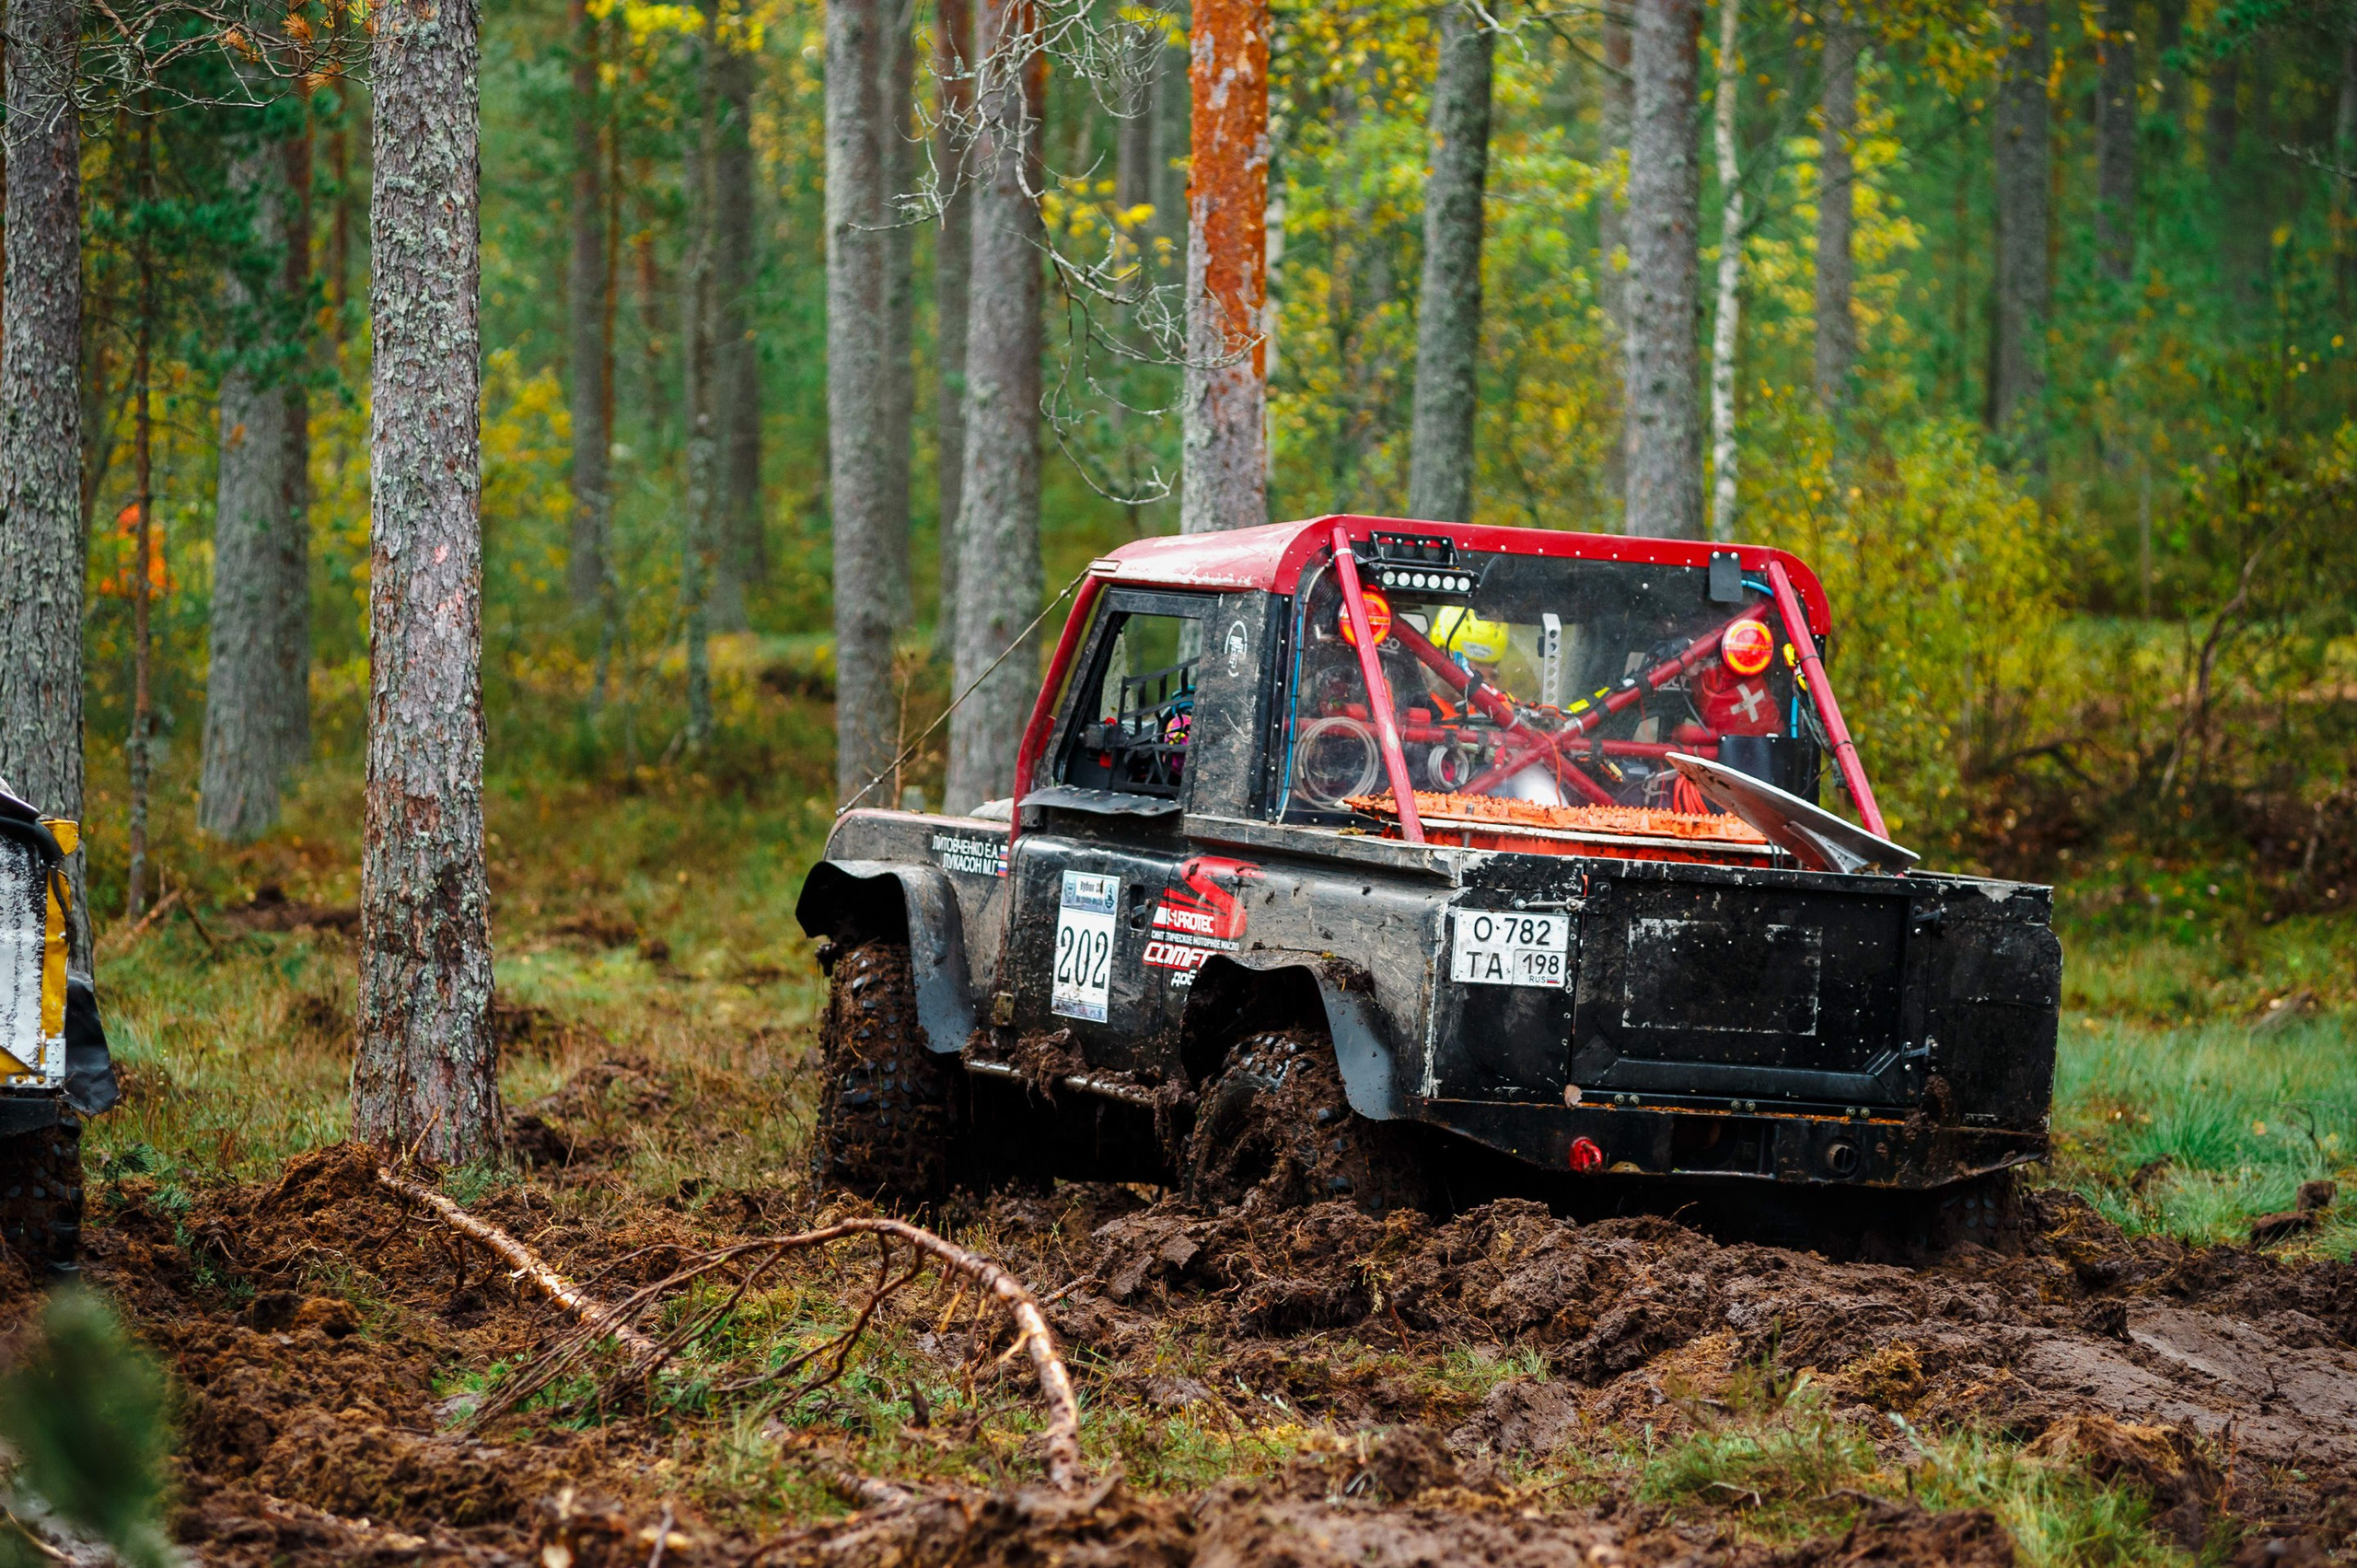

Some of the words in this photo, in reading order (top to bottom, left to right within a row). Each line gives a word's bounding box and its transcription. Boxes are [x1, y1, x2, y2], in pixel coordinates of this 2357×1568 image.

[932, 835, 984, 857] ЛИТОВЧЕНКО
[942, 853, 982, 875] ЛУКАСОН
[1504, 917, 1550, 946] 782
[1058, 925, 1109, 990] 202
[1522, 953, 1560, 975] 198
[1528, 975, 1546, 983] RUS
